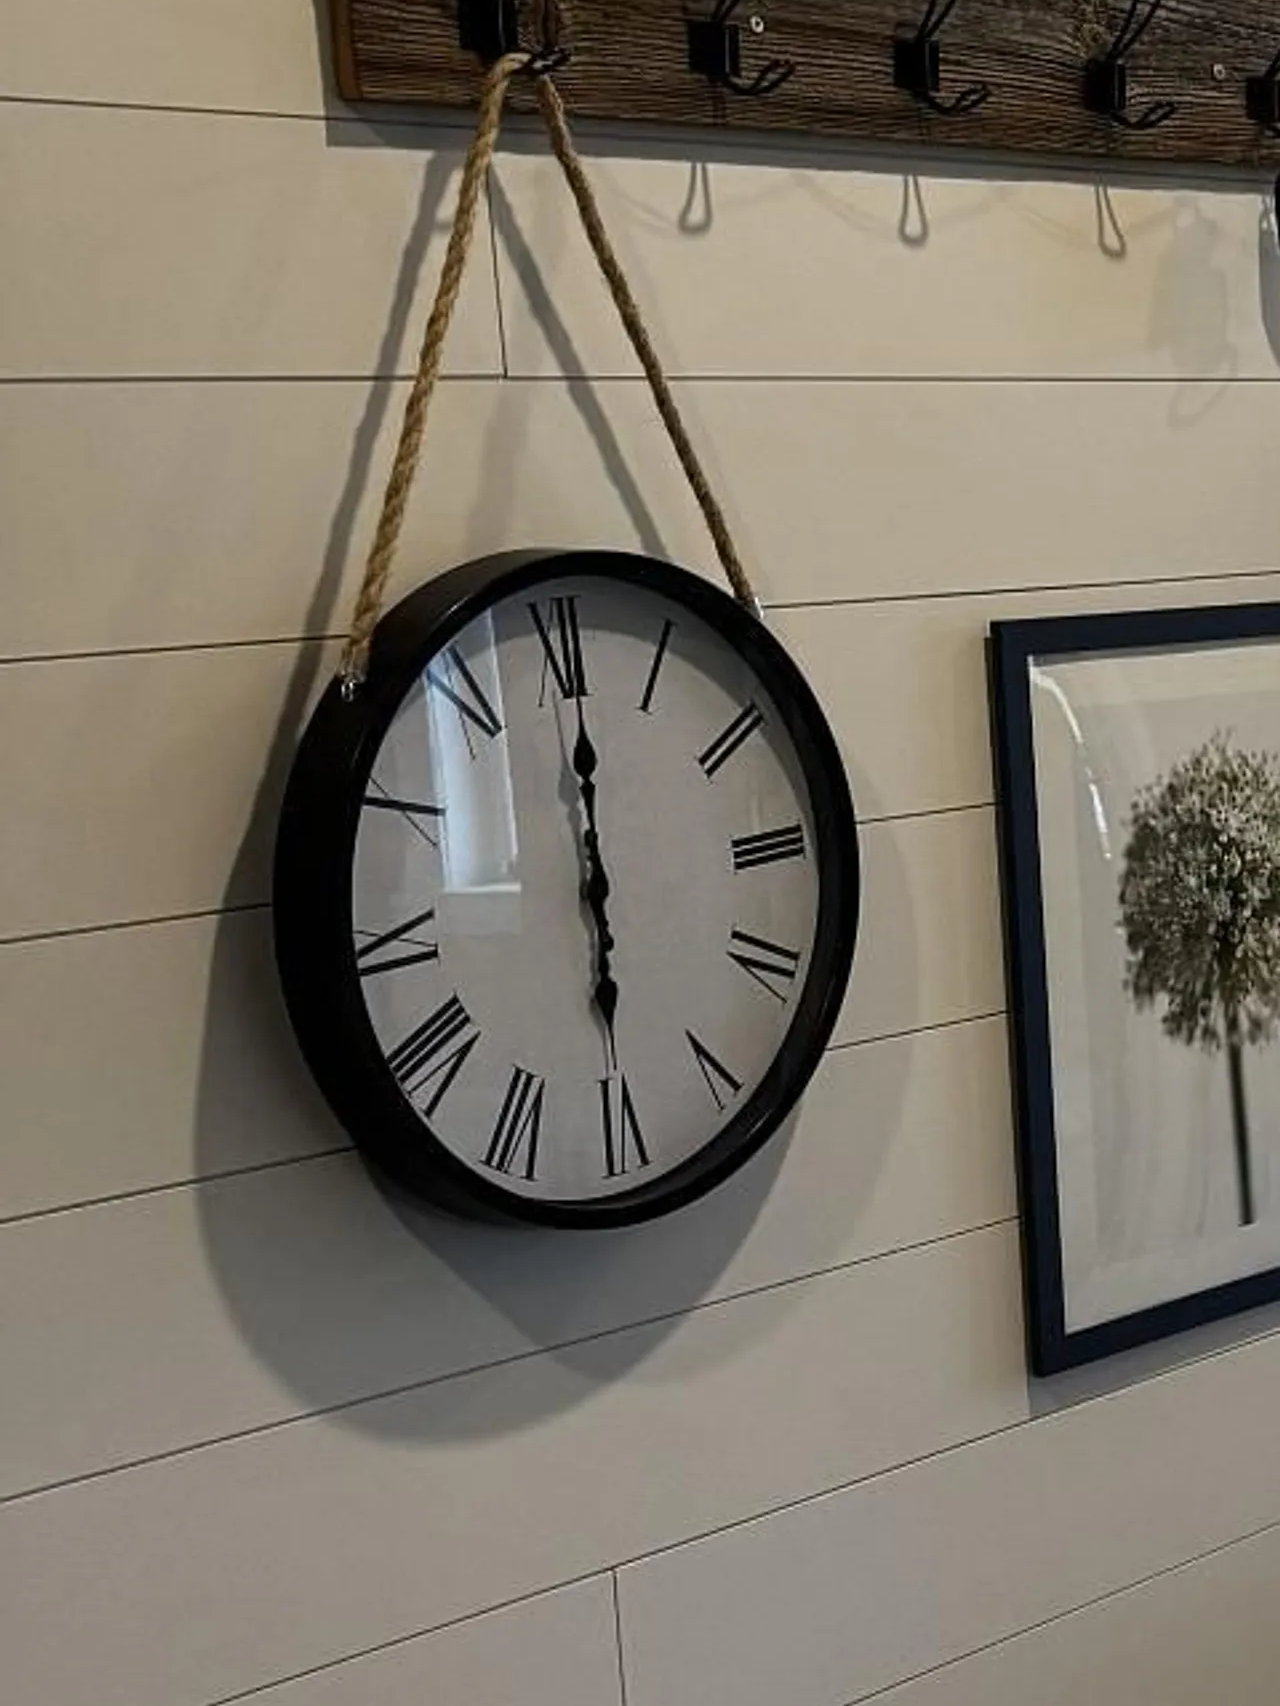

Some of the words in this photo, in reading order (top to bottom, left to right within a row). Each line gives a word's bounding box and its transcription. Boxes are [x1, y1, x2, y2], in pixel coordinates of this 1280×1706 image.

[426, 643, 508, 760] XI
[529, 595, 595, 708] XII
[354, 905, 441, 979] IX
[726, 925, 801, 1011] IV
[386, 993, 481, 1121] VIII
[685, 1027, 744, 1114] V
[478, 1062, 546, 1182] VII
[597, 1073, 654, 1180] VI
